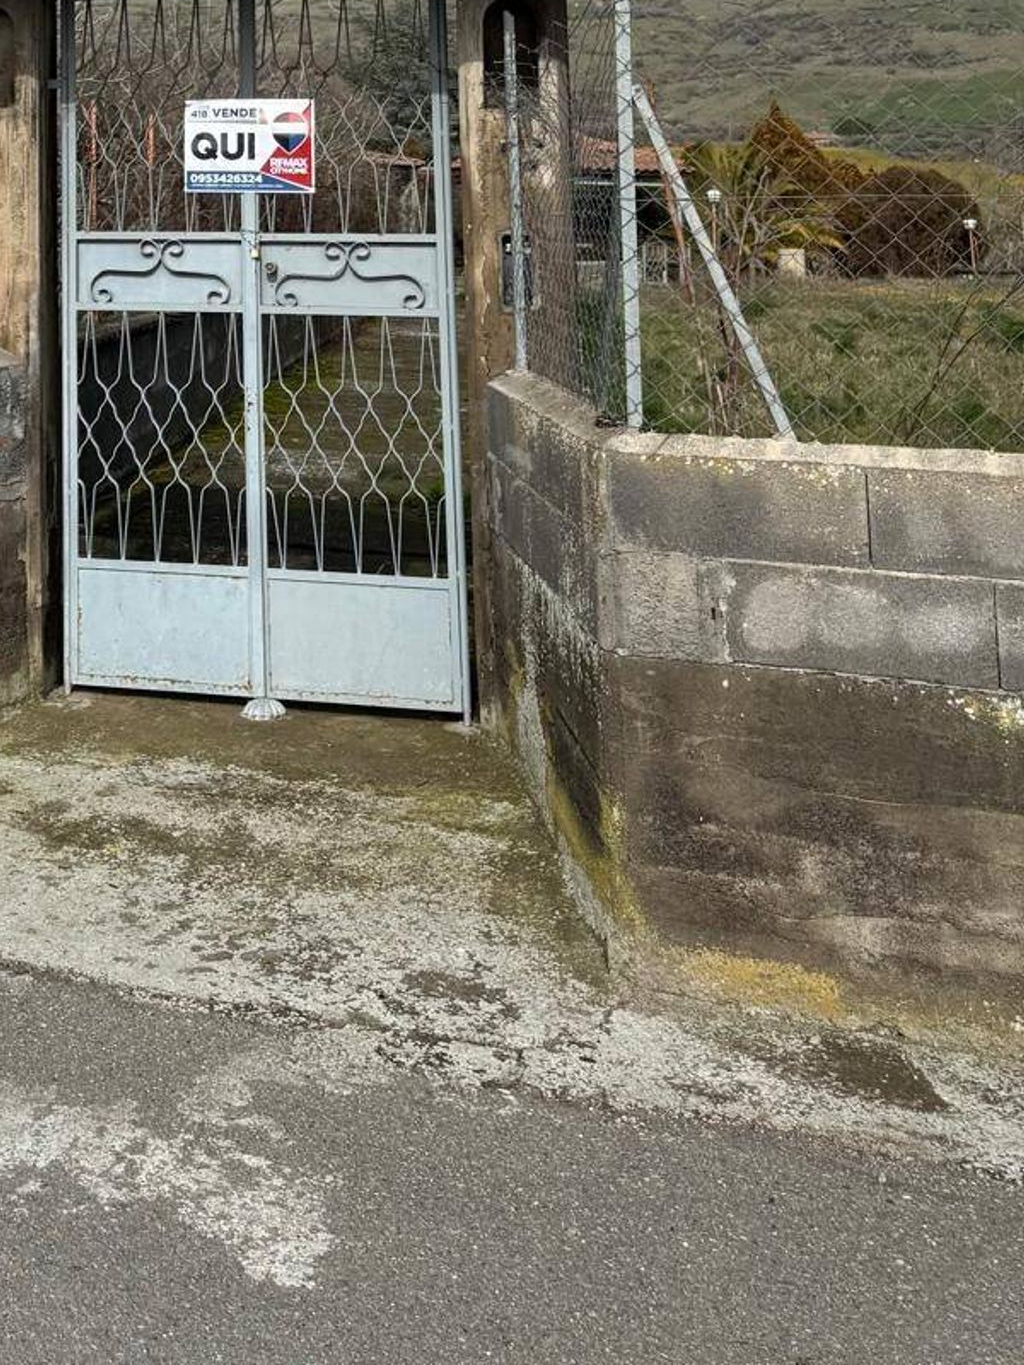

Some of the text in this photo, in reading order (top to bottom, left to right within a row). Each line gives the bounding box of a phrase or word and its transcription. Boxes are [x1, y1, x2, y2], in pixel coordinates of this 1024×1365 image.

[211, 108, 257, 119] VENDE
[191, 132, 256, 161] QUI
[190, 173, 263, 183] 0953426324
